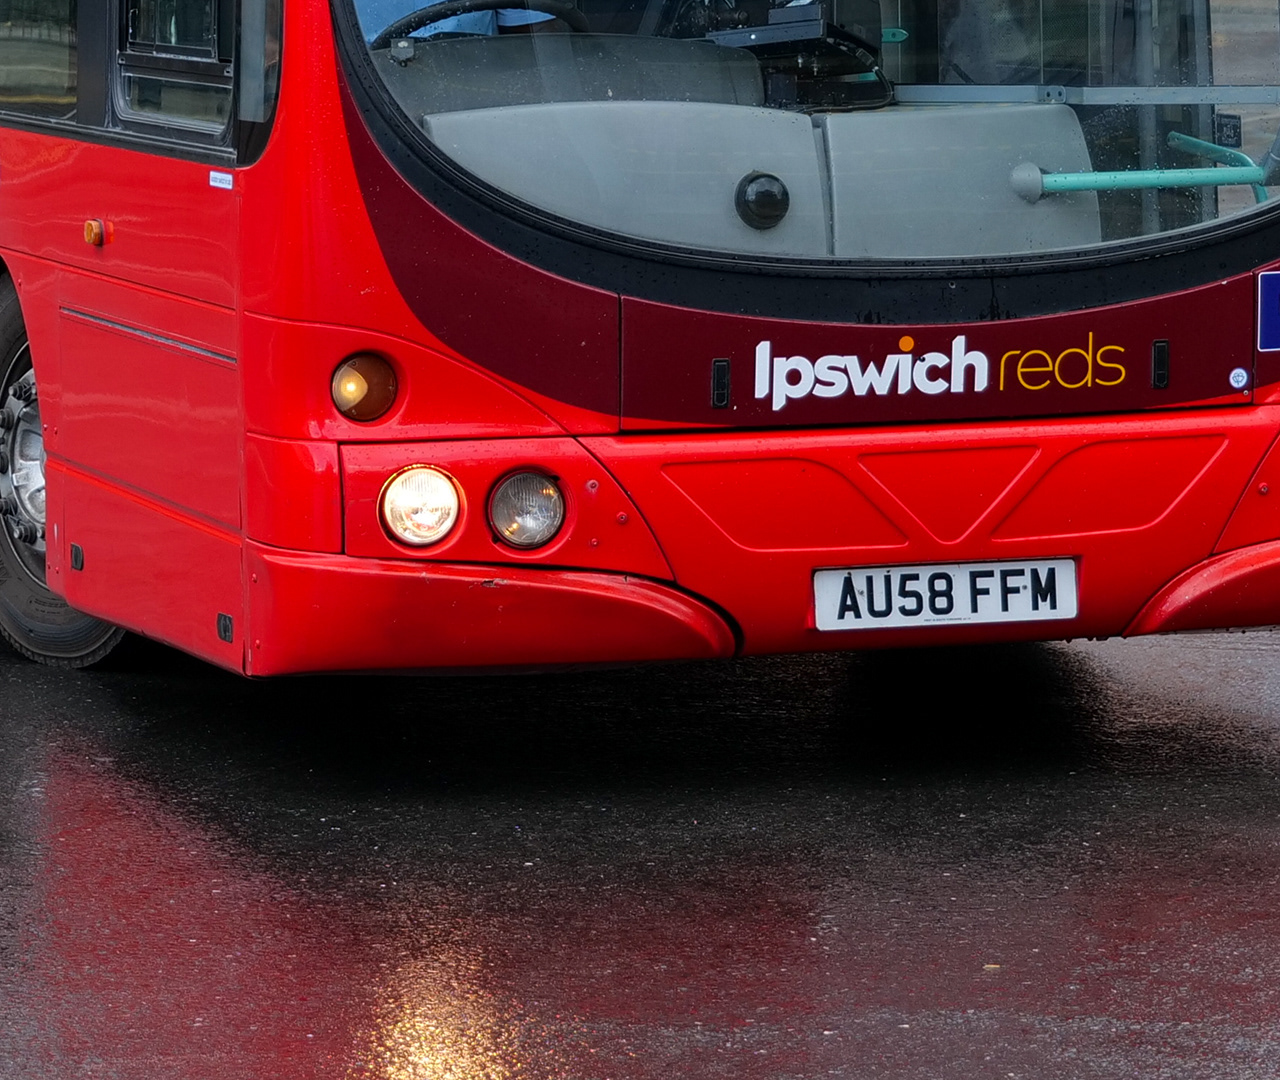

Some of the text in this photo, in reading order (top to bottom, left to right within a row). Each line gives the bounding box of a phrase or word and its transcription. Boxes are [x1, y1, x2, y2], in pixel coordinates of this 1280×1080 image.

[754, 331, 1126, 411] Ipswich reds
[836, 565, 1058, 622] AU58 FFM
